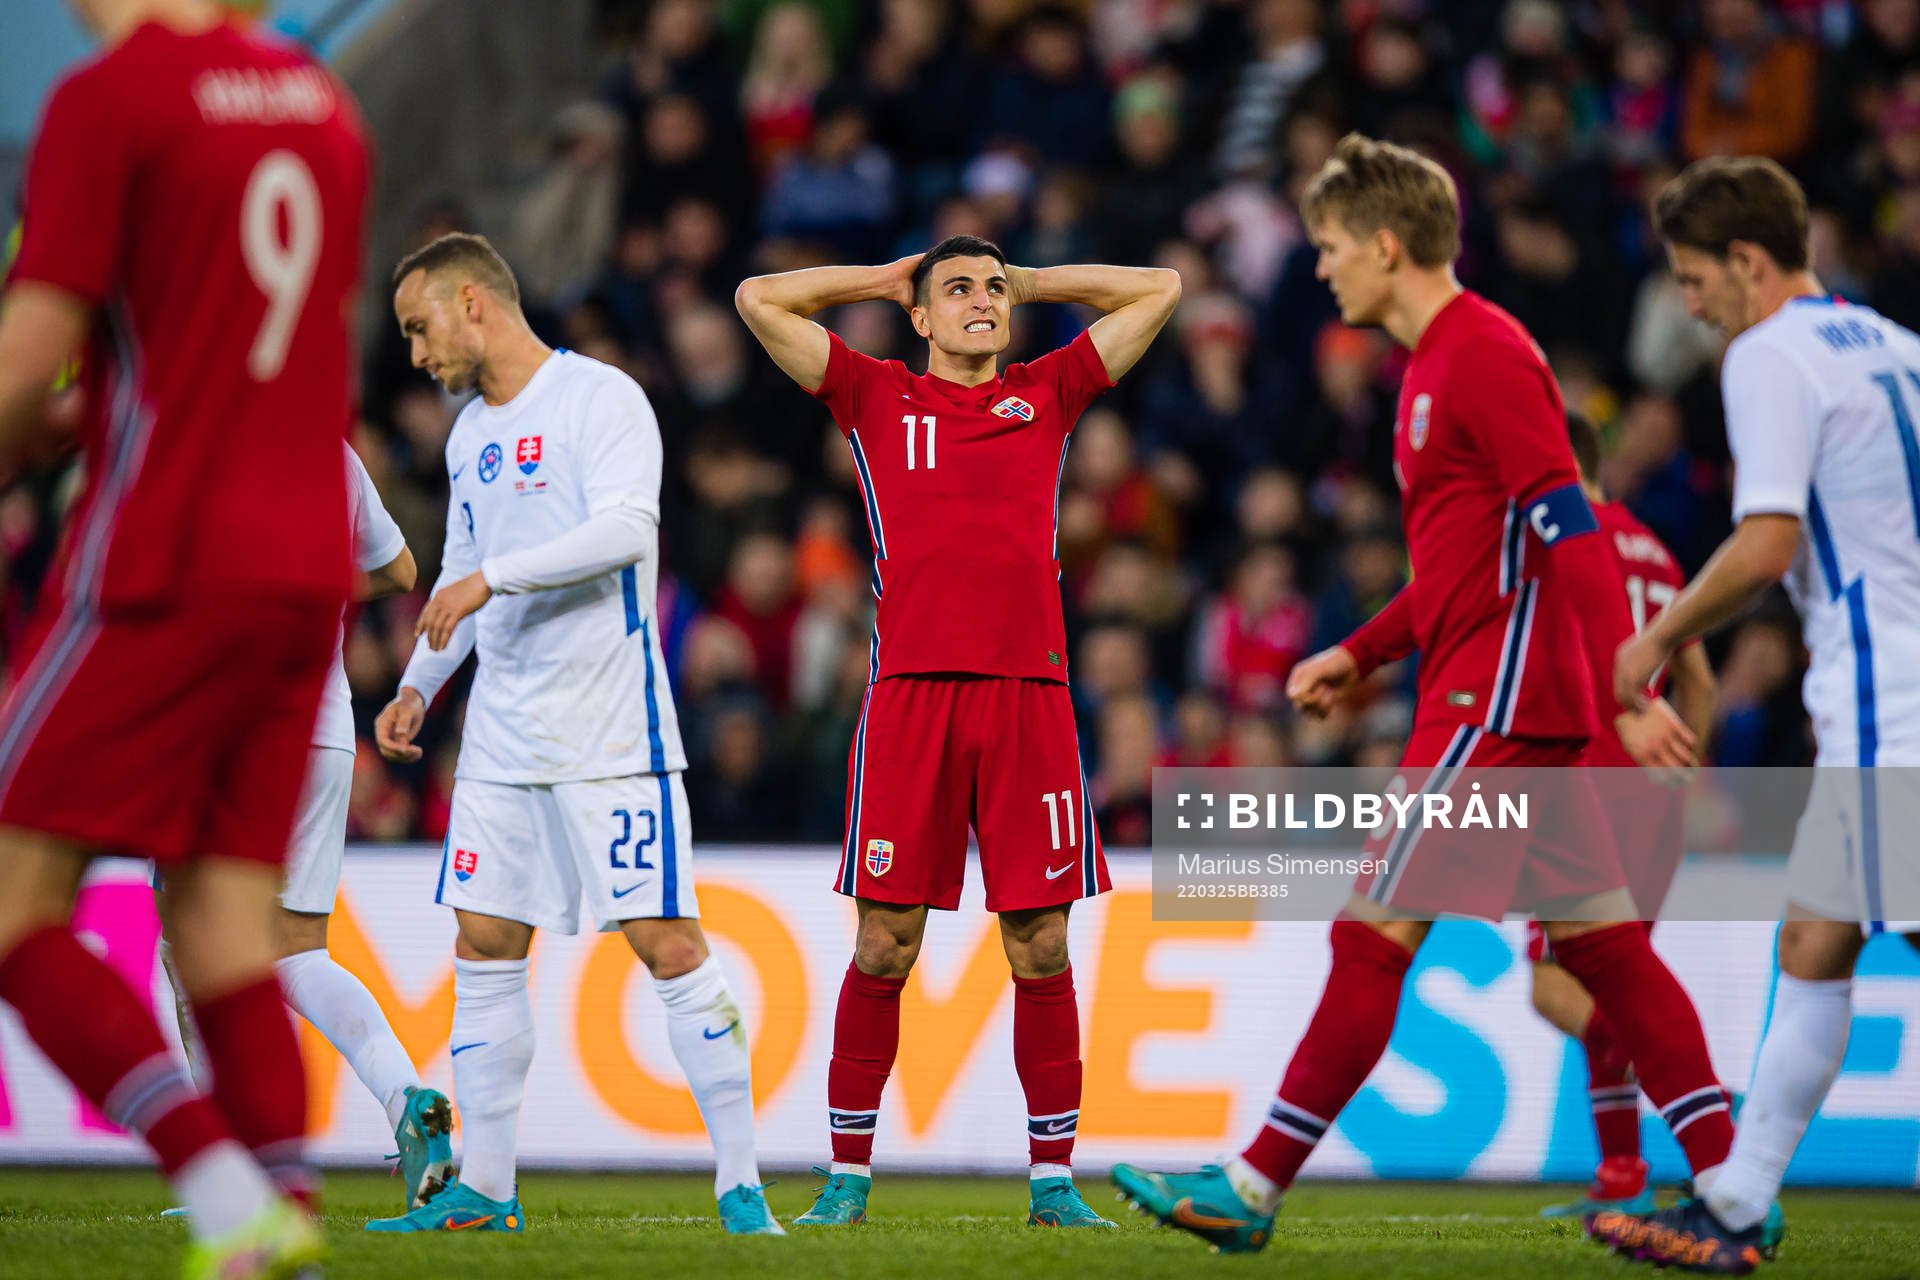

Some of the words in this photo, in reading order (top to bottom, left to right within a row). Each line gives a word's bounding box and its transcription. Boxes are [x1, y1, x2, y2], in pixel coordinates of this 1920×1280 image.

[241, 149, 324, 383] 9
[902, 415, 936, 470] 11
[1869, 371, 1920, 541] 1
[1530, 502, 1560, 544] C
[610, 809, 656, 869] 22
[1042, 790, 1075, 850] 11
